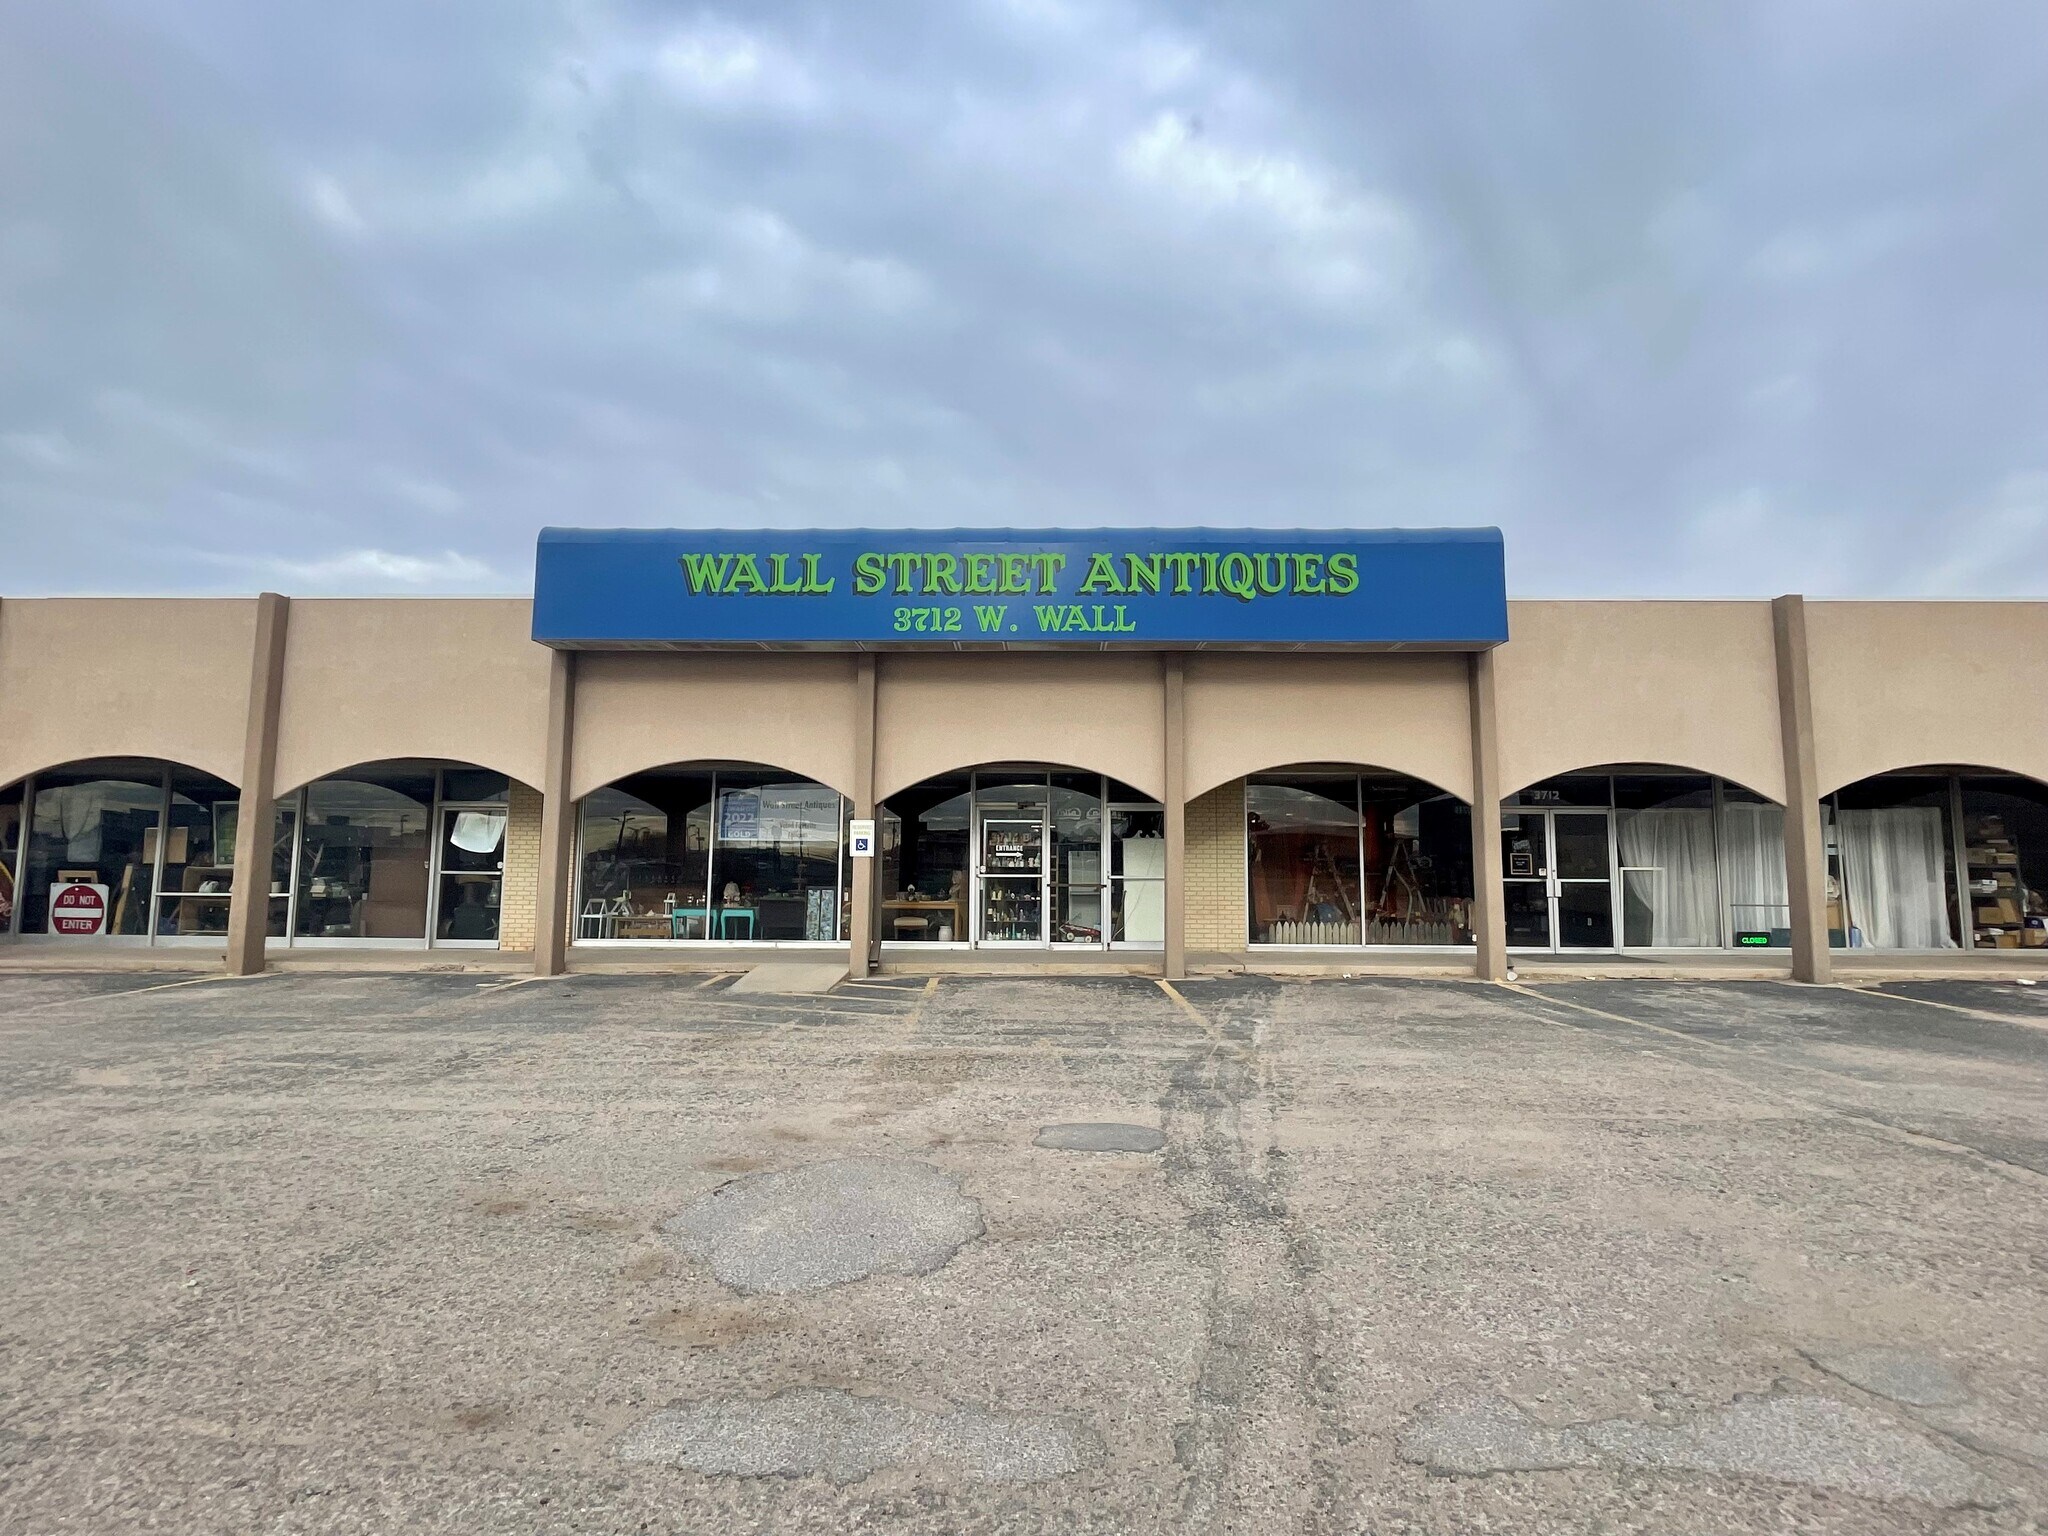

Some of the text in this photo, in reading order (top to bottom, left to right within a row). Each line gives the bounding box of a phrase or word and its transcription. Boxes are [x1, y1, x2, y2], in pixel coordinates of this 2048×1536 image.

[680, 552, 1360, 601] WALL STREET ANTIQUES
[893, 605, 1136, 632] 3712 W. WALL
[1534, 790, 1560, 800] 3712
[804, 801, 835, 810] Antiques
[724, 813, 755, 822] 2022
[995, 844, 1024, 852] ENTRANCE
[63, 894, 96, 906] DO NOT
[62, 919, 93, 930] ENTER
